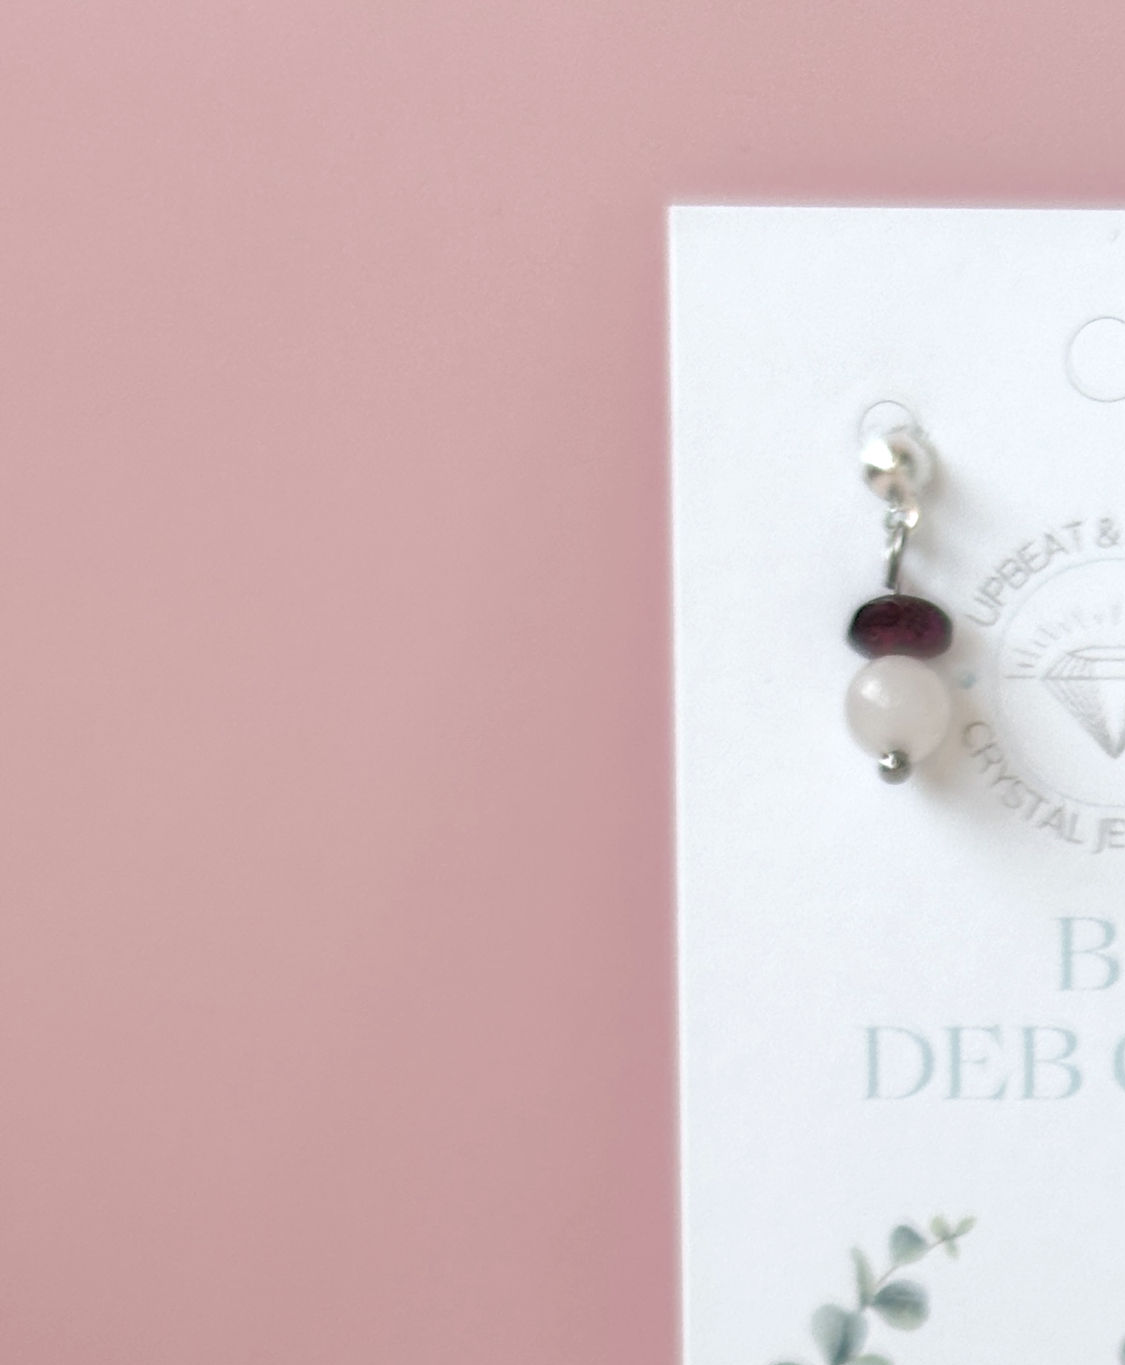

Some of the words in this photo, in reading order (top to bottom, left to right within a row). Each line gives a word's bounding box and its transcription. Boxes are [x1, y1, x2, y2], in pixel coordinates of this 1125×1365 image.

[966, 520, 1083, 627] UPBEAT
[1098, 517, 1121, 549] &
[963, 720, 1084, 844] CRYSTAL
[862, 1024, 1084, 1101] DEB
